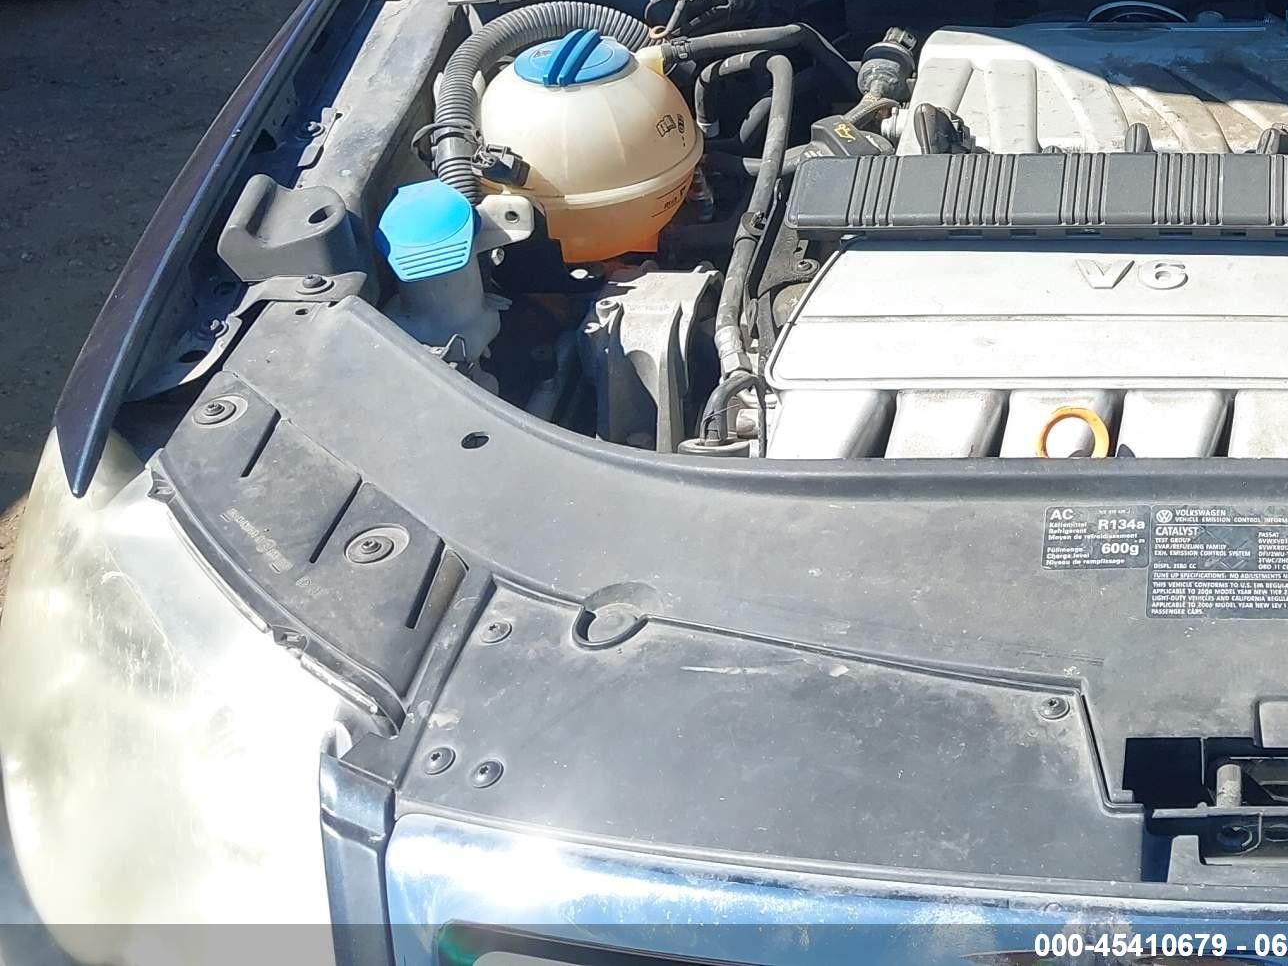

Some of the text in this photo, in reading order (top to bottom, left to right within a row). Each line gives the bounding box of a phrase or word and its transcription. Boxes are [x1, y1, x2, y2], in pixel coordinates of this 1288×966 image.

[1074, 259, 1188, 290] V6
[1050, 508, 1074, 520] AC
[1098, 519, 1145, 530] R134a
[1156, 527, 1198, 536] CATALYST
[1102, 543, 1139, 556] 600g
